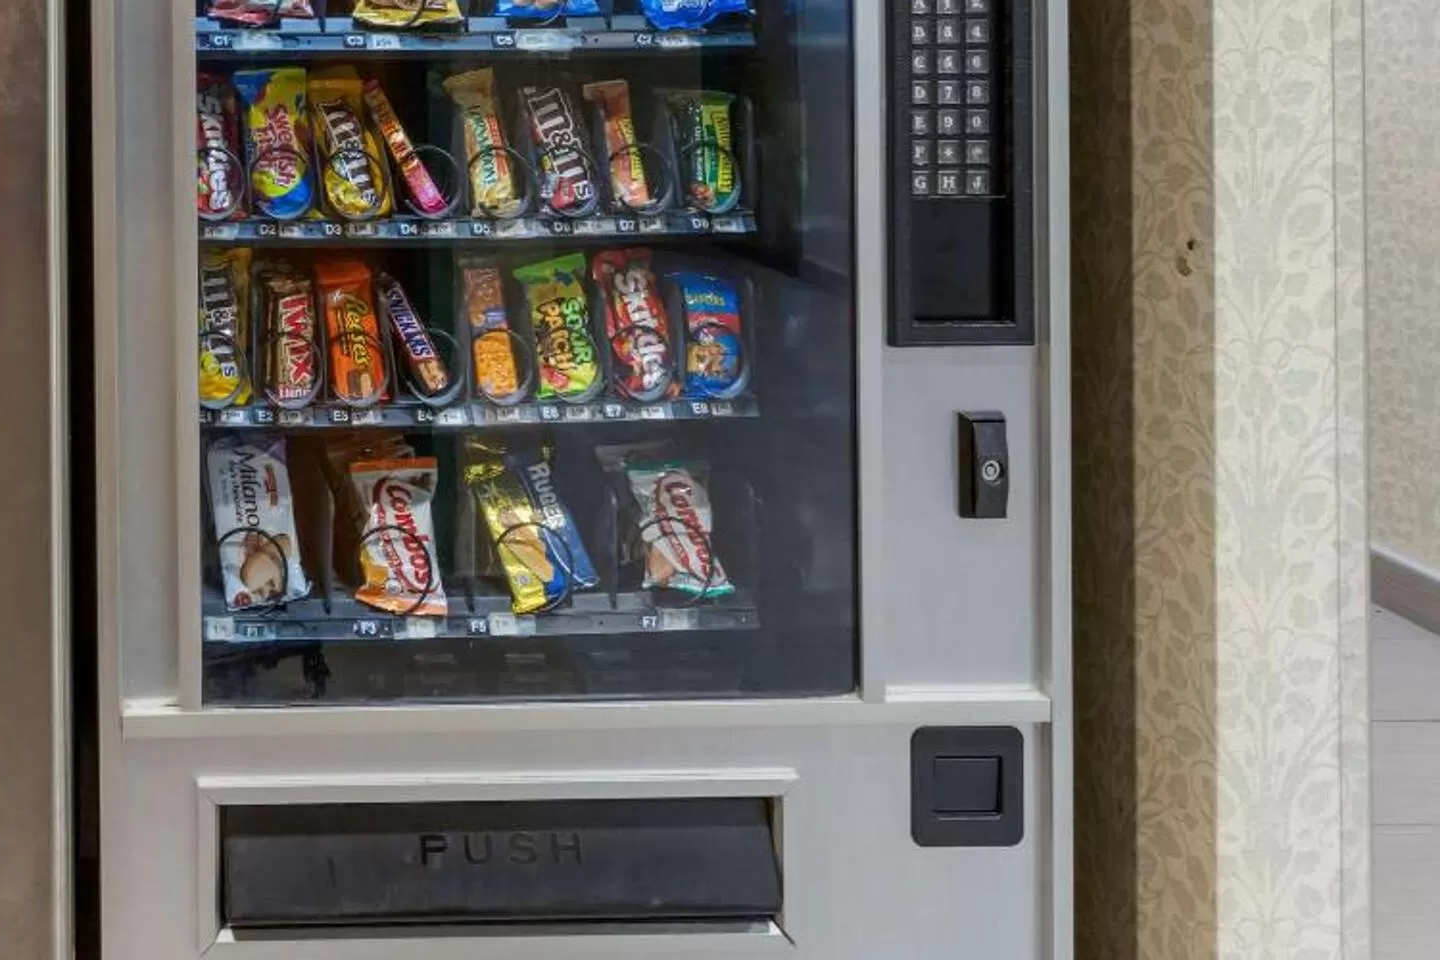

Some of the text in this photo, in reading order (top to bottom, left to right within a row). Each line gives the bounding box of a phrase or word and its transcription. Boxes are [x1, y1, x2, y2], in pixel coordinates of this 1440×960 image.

[560, 299, 592, 365] SOUR
[233, 449, 261, 528] Milano
[420, 832, 583, 867] PUSH
